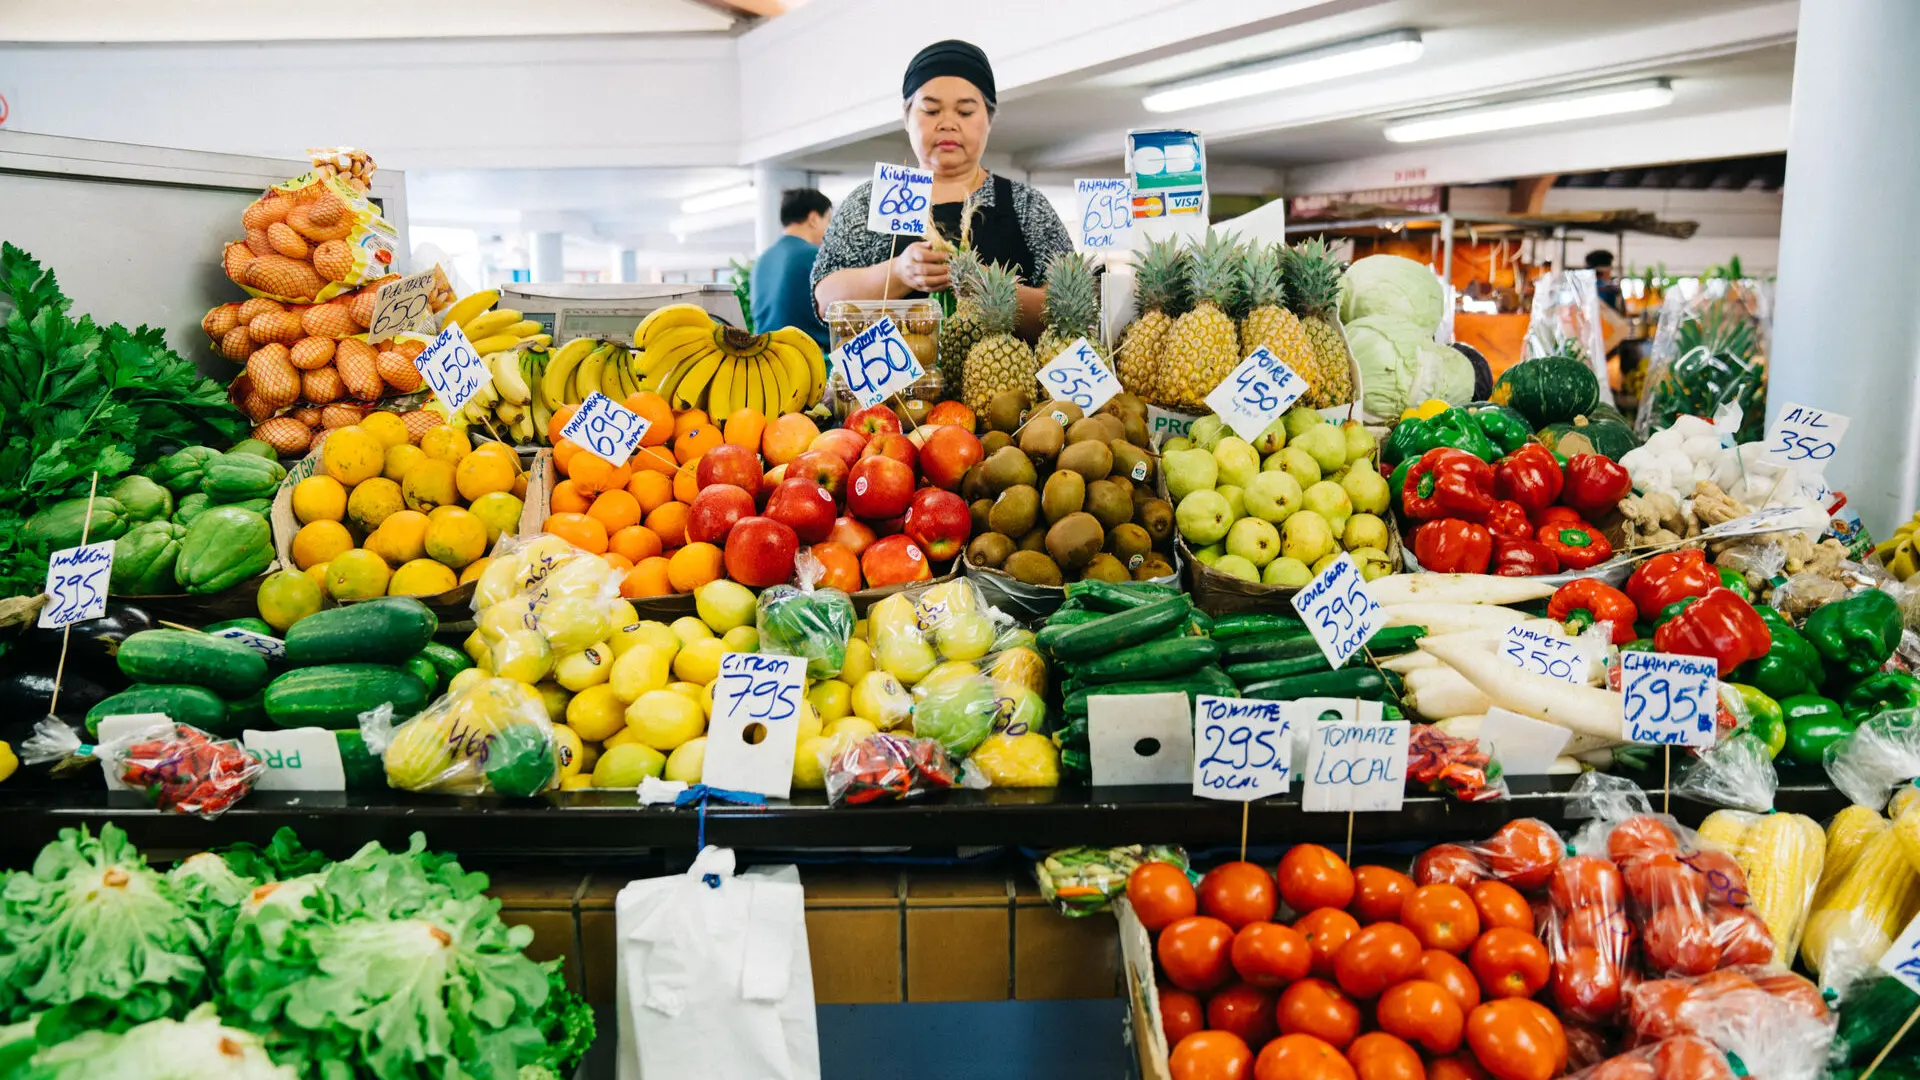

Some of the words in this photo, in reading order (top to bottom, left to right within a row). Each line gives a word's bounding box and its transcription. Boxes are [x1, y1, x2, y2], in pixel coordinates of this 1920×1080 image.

[879, 184, 927, 215] 680
[1079, 178, 1127, 194] ANANAS
[1174, 197, 1200, 208] VISA
[1083, 192, 1130, 232] 695
[1083, 232, 1115, 247] LOCAL
[373, 293, 429, 335] 650
[415, 328, 453, 372] ORANGE
[842, 317, 896, 362] POMME
[427, 346, 471, 392] 450
[841, 337, 913, 393] 450
[1076, 344, 1109, 383] Kiwi
[1250, 348, 1293, 388] POIRE
[448, 376, 479, 408] LOCAL
[1048, 367, 1093, 409] 650
[1236, 364, 1279, 412] 450
[584, 400, 632, 457] 695
[1769, 429, 1836, 460] 350
[47, 568, 104, 618] 395
[1315, 580, 1369, 645] 395
[53, 608, 88, 624] LOCAL
[1336, 621, 1371, 660] LOCAL
[1507, 625, 1572, 650] NAVET
[722, 673, 801, 720] 795
[1201, 699, 1281, 722] TOMATE
[1623, 672, 1698, 724] 695
[1199, 725, 1276, 770] 295
[1317, 723, 1399, 748] TOMATE
[1631, 722, 1689, 745] LOCAL
[1202, 769, 1259, 789] LOCAL
[1313, 750, 1399, 786] LOCAL
